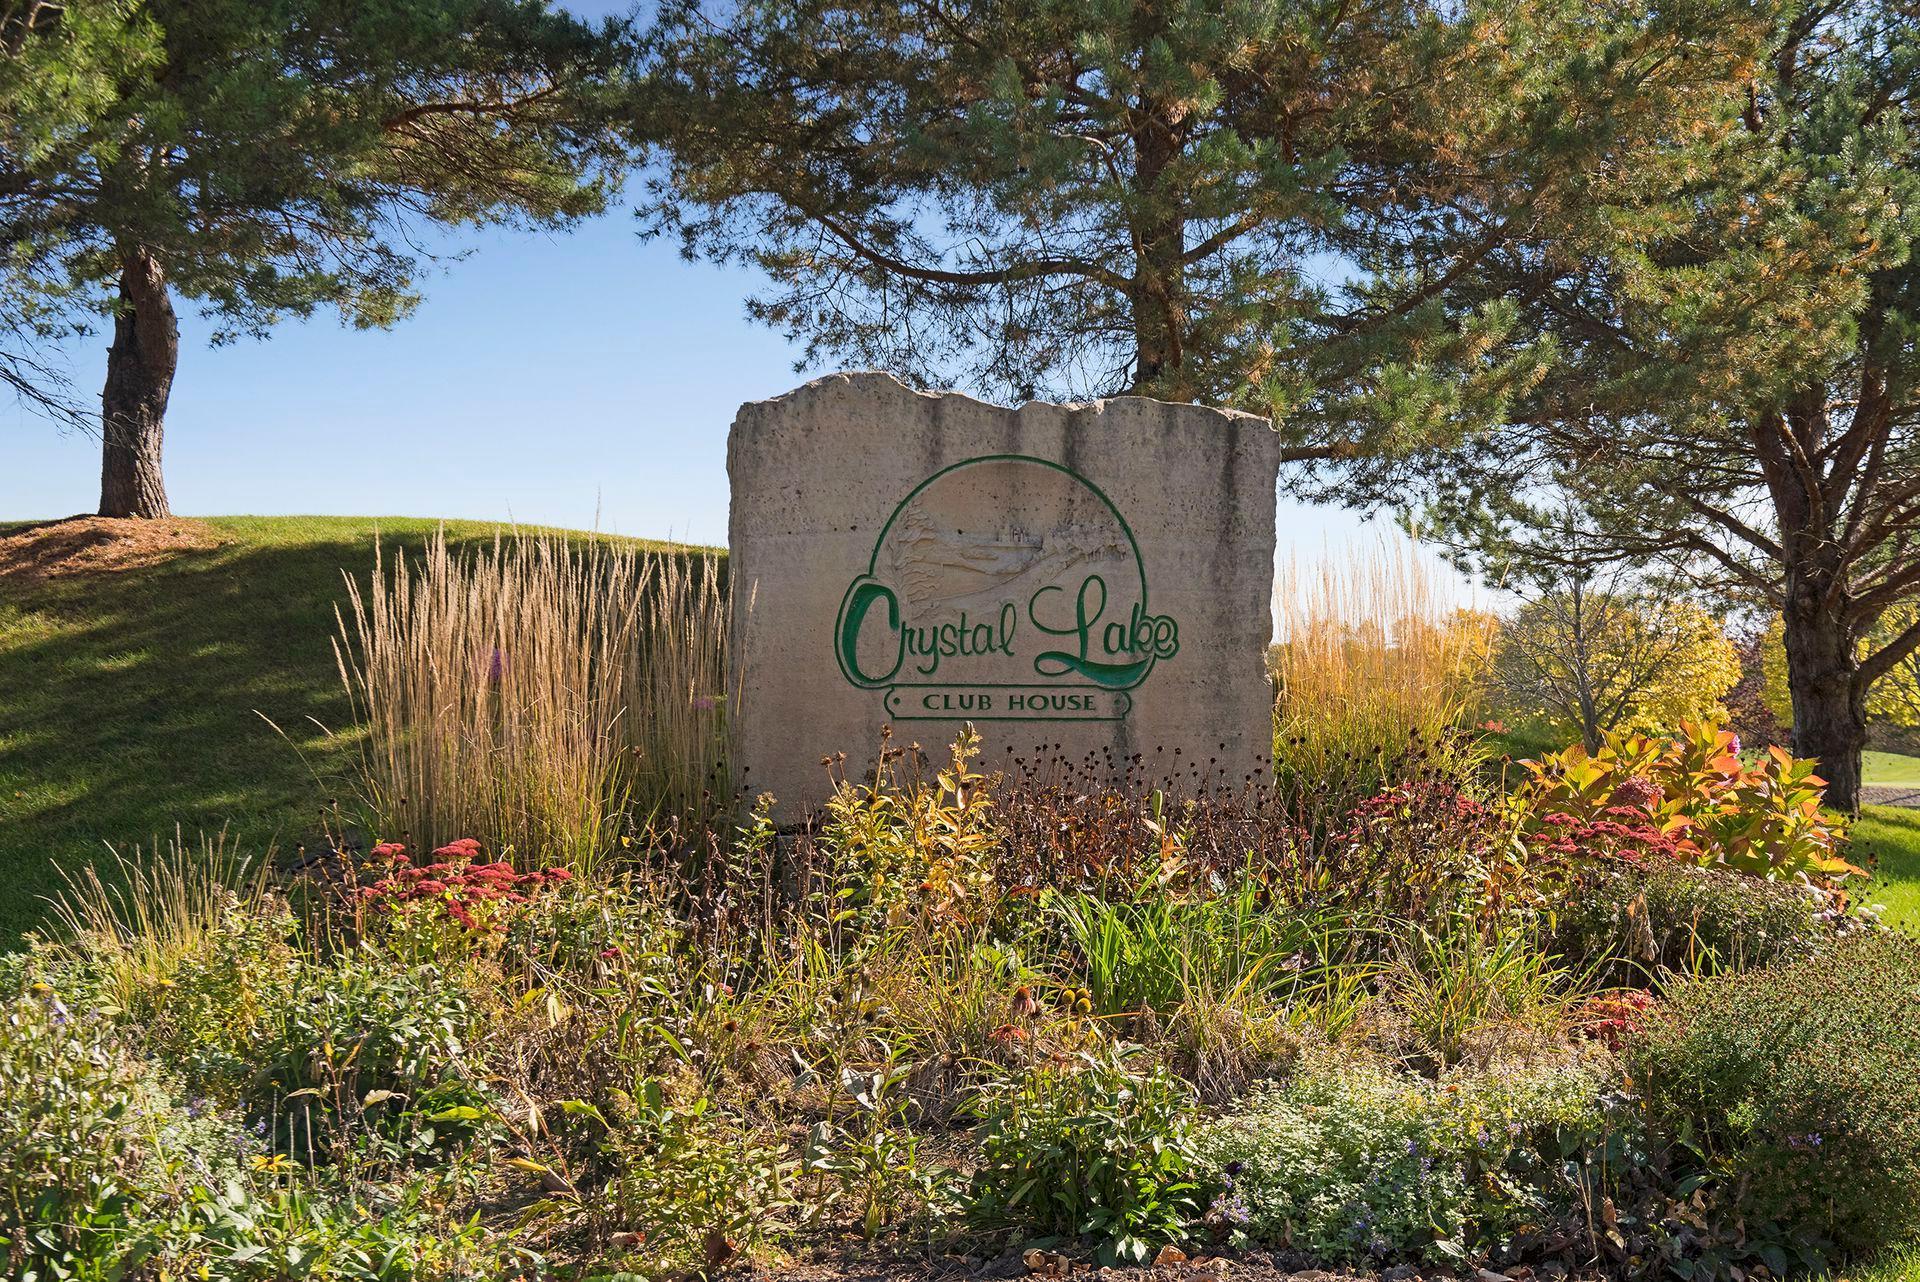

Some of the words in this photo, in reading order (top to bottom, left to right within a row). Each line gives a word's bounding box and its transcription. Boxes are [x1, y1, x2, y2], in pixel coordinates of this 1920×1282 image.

[842, 583, 1017, 683] Crystal
[1029, 575, 1176, 686] Lake
[922, 694, 993, 712] CLUB
[1008, 694, 1098, 712] HOUSE
